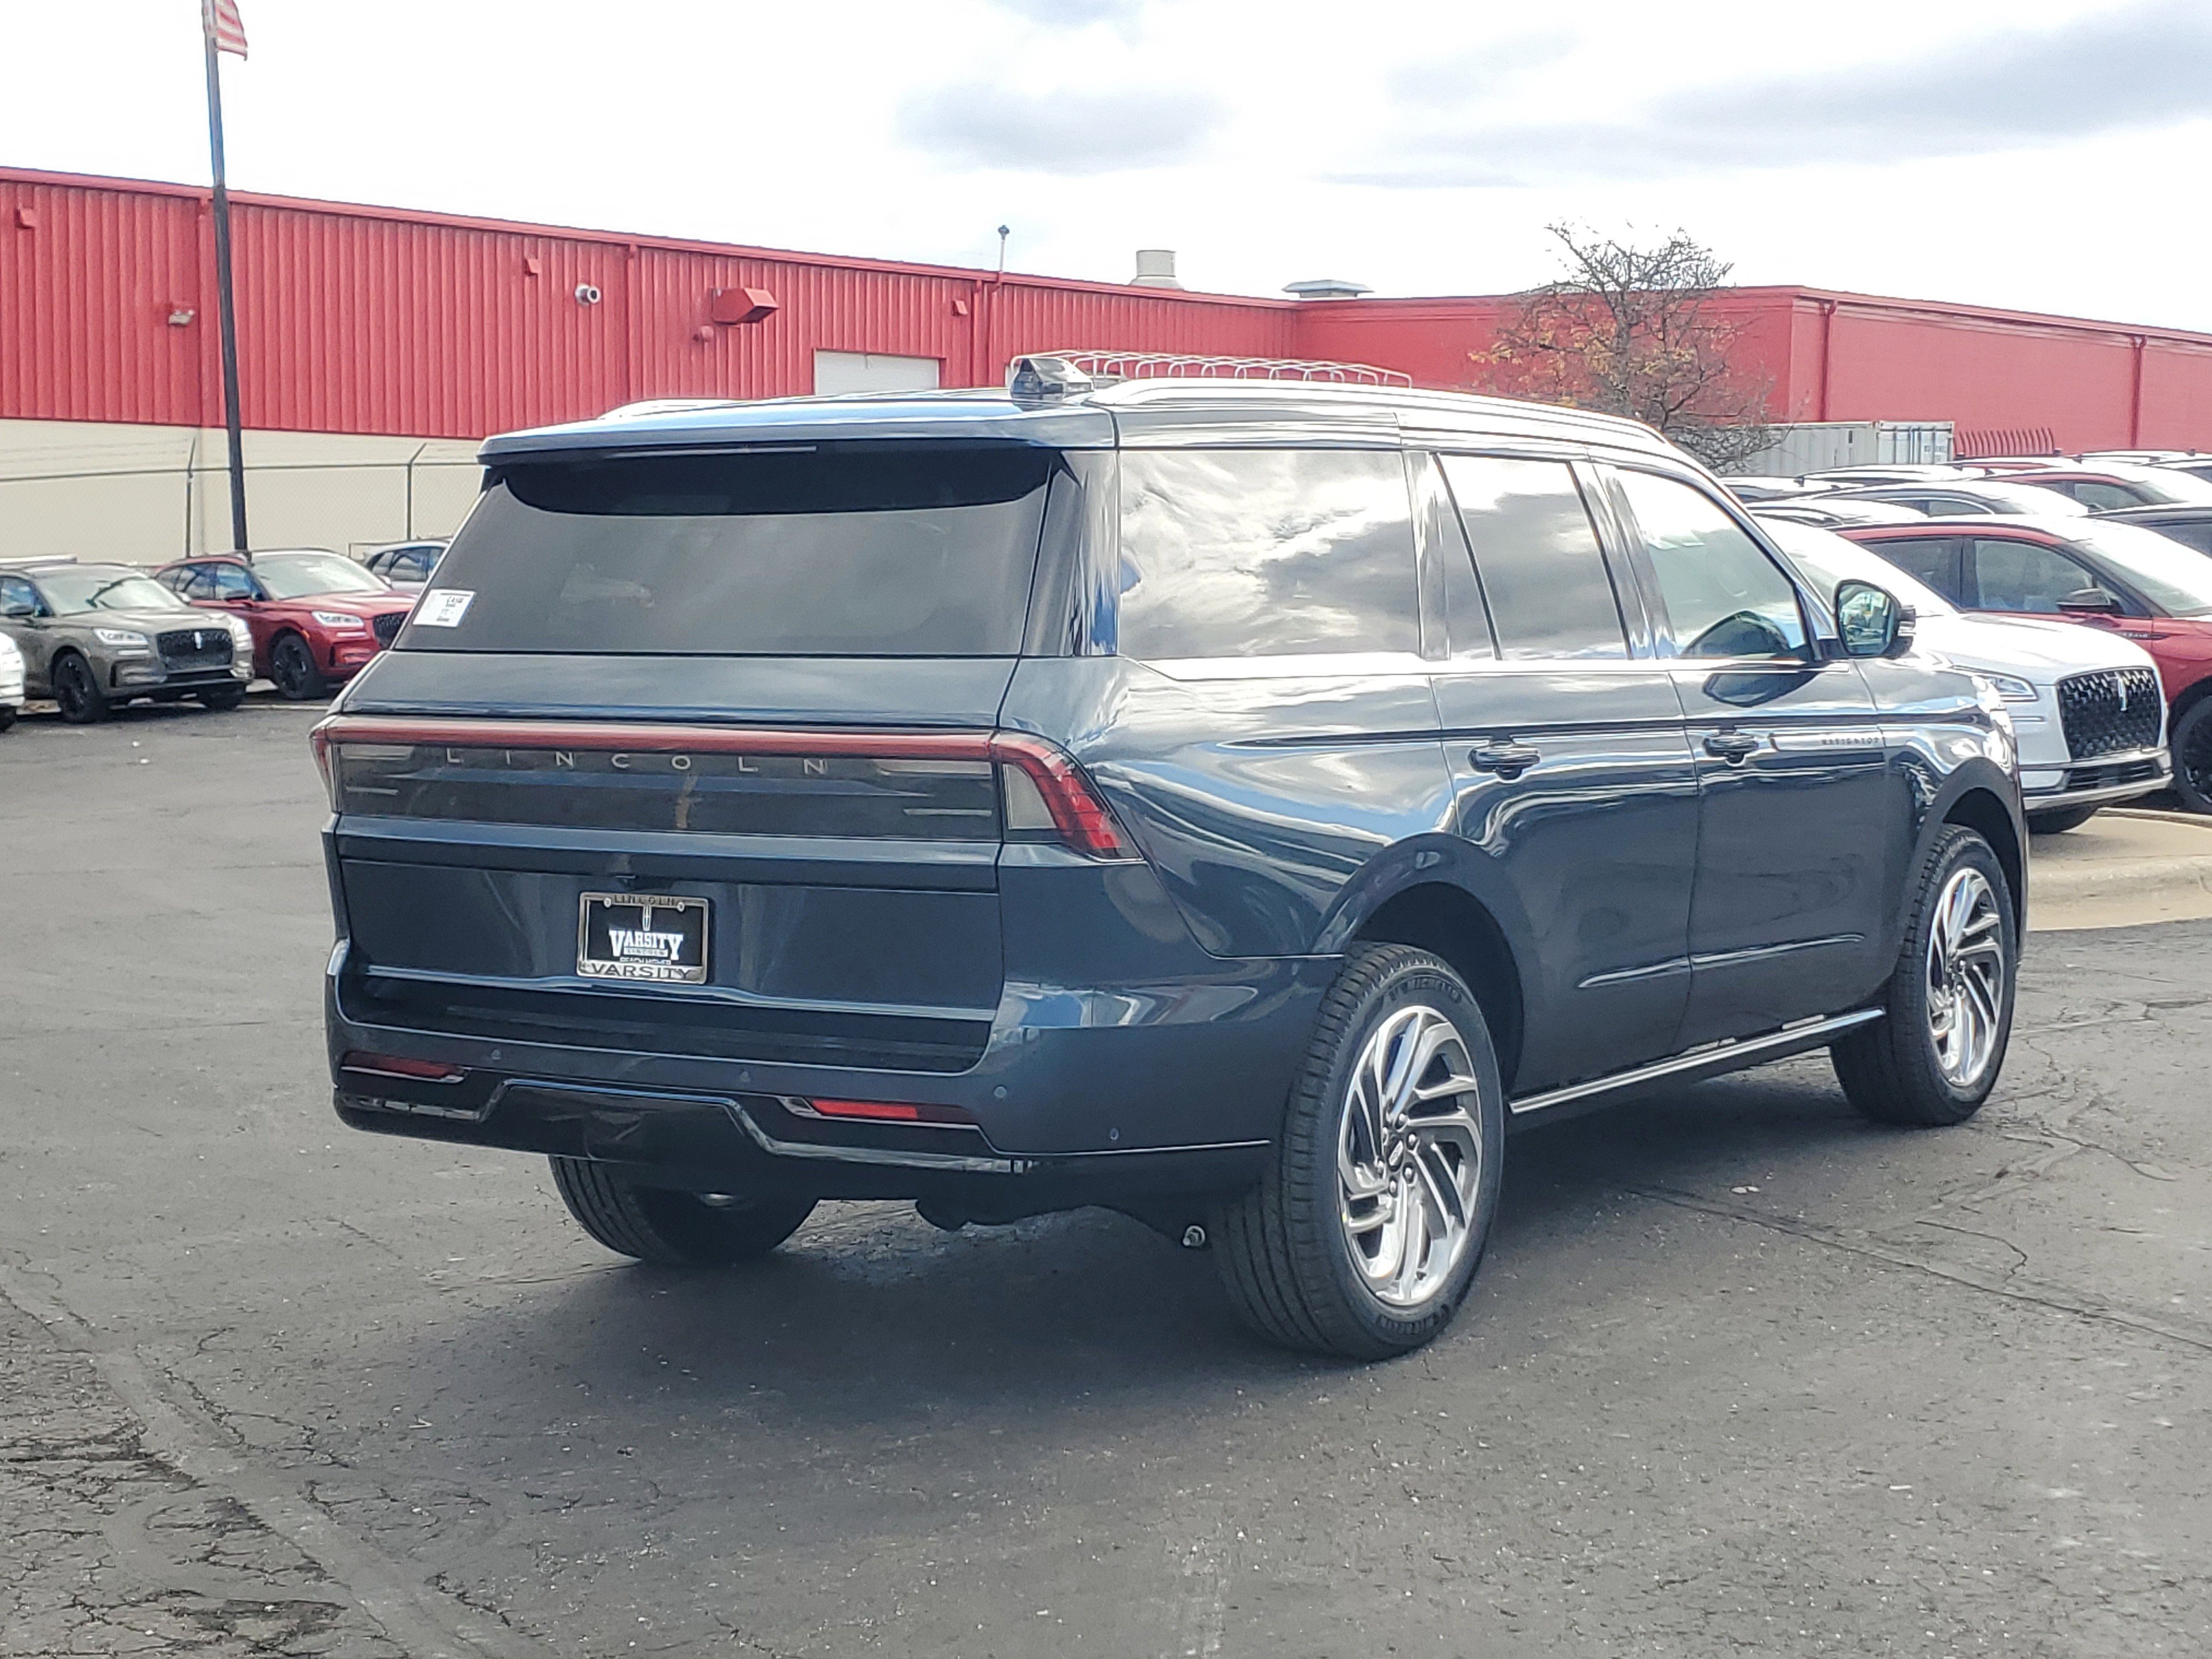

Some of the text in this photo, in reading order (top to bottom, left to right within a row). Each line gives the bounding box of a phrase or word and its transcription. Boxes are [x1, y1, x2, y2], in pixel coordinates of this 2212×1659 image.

[446, 748, 826, 775] LINCOLN
[614, 894, 675, 906] LINCOLN
[608, 929, 684, 961] VARSITY
[591, 963, 692, 980] VARSITY
